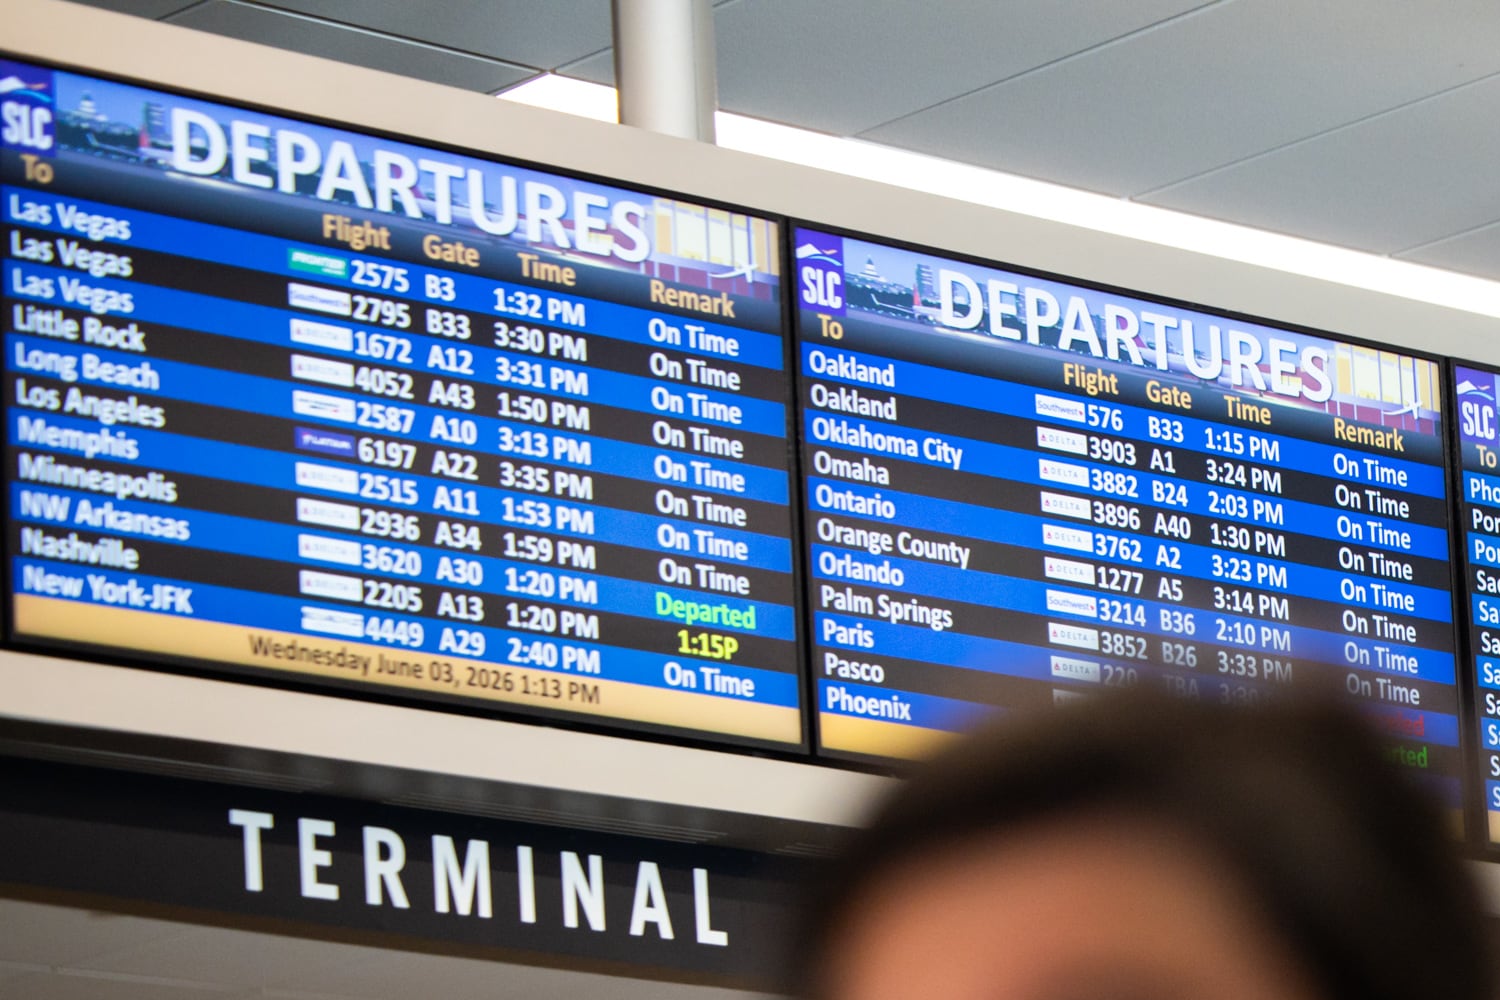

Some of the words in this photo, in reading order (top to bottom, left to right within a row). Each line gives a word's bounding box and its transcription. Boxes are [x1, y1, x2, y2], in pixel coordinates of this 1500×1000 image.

[1, 100, 53, 150] SLC
[170, 107, 651, 263] DEPARTURES
[11, 231, 54, 262] Las
[57, 239, 134, 278] Vegas
[21, 156, 54, 184] To
[323, 214, 391, 251] Flight
[423, 235, 480, 268] Gate
[517, 252, 576, 287] Time
[650, 278, 735, 318] Remark
[10, 195, 52, 225] Las
[56, 203, 131, 242] Vegas
[351, 259, 410, 293] 2575
[424, 273, 456, 302] B3
[493, 287, 543, 319] 1:32
[547, 297, 586, 327] PM
[648, 317, 681, 346] On
[684, 324, 739, 357] Time
[13, 268, 55, 299] Las
[58, 276, 135, 315] Vegas
[801, 265, 843, 310] SLC
[14, 305, 80, 340] Little
[84, 316, 147, 352] Rock
[938, 268, 1334, 402] DEPARTURES
[15, 342, 78, 383] Long
[82, 353, 160, 390] Beach
[817, 314, 844, 340] To
[1063, 362, 1119, 396] Flight
[1145, 379, 1192, 410] Gate
[1223, 394, 1272, 425] Time
[1333, 417, 1405, 452] Remark
[17, 379, 61, 410] Los
[64, 387, 166, 428] Angeles
[809, 350, 895, 388] Oakland
[1037, 400, 1079, 417] Southwest
[1087, 404, 1124, 431] 576
[1148, 415, 1184, 443] B33
[1204, 427, 1245, 455] 1:15
[1249, 435, 1280, 462] PM
[1333, 452, 1360, 478] On
[1363, 458, 1408, 487] Time
[1461, 400, 1496, 441] SLC
[18, 415, 140, 460] Memphis
[810, 383, 897, 421] Oakland
[1048, 433, 1076, 447] DELTA
[1089, 436, 1137, 466] 3903
[1150, 448, 1176, 474] A1
[1206, 458, 1247, 487] 3:24
[1251, 467, 1282, 494] PM
[1335, 484, 1361, 509] On
[1364, 489, 1410, 518] Time
[812, 417, 919, 458] Oklahoma
[923, 437, 963, 471] City
[1475, 444, 1497, 468] To
[19, 453, 178, 502] Minneapolis
[814, 450, 890, 485] Omaha
[1093, 500, 1141, 530] 3896
[1154, 512, 1192, 539] A40
[815, 483, 896, 519] Ontario
[20, 490, 71, 522] NW
[74, 499, 190, 541] Arkansas
[360, 543, 422, 577] 3620
[436, 556, 483, 586] A30
[505, 567, 555, 598] 1:20
[558, 575, 598, 604] PM
[655, 591, 757, 630] Departed
[817, 517, 893, 555] Orange
[897, 531, 971, 570] County
[21, 527, 140, 570] Nashville
[361, 579, 423, 612] 2205
[437, 592, 485, 621] A13
[506, 602, 557, 633] 1:20
[560, 610, 600, 640] PM
[678, 629, 739, 660] 1:15P
[23, 565, 84, 597] New
[87, 574, 193, 614] York-JFK
[362, 616, 425, 648] 4449
[439, 627, 486, 657] A29
[819, 551, 905, 587] Orlando
[1048, 596, 1089, 612] Southwest
[1099, 598, 1147, 627] 3214
[1159, 608, 1196, 636] B36
[1215, 618, 1256, 646] 2:10
[1260, 626, 1291, 652] PM
[821, 584, 874, 615] Palm
[877, 593, 953, 632] Springs
[823, 618, 875, 649] Paris
[824, 652, 885, 683] Pasco
[826, 686, 911, 721] Phoenix
[228, 808, 729, 947] TERMINAL
